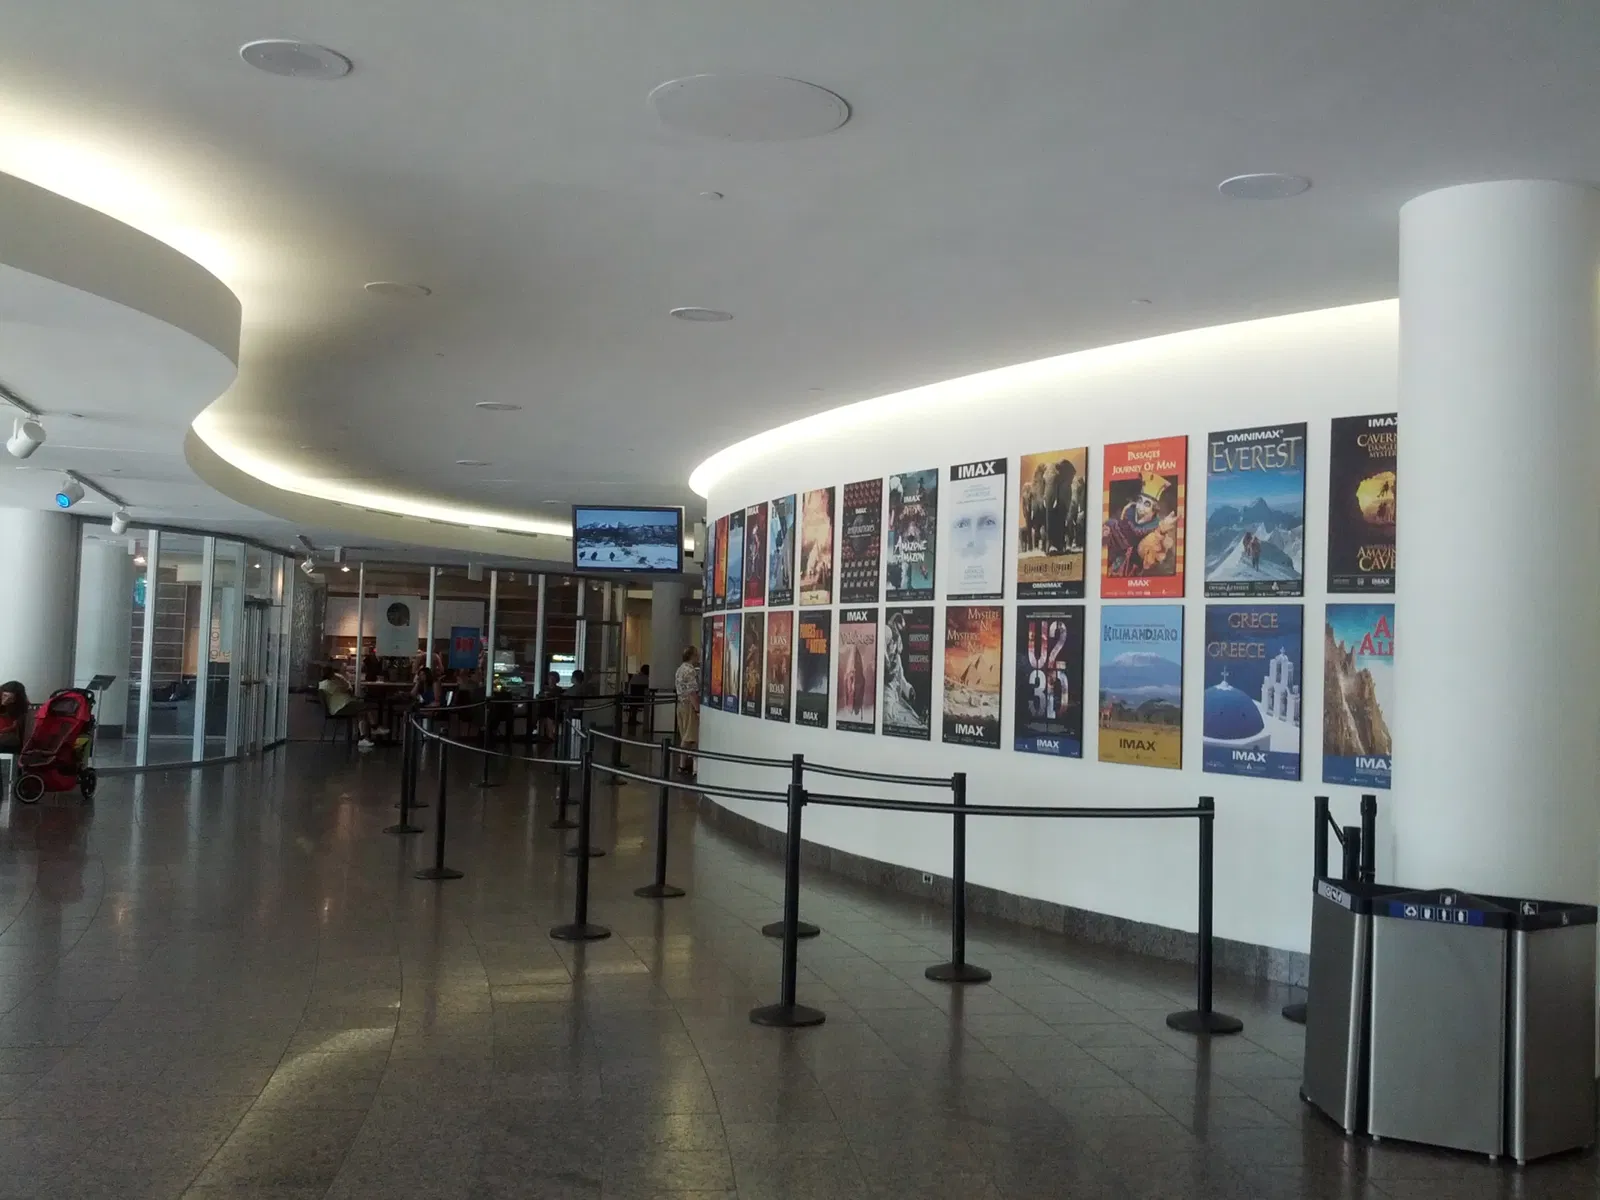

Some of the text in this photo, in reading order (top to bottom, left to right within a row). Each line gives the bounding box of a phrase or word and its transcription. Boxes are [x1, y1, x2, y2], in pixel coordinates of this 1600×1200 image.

[1127, 450, 1160, 460] PASSAGES
[1211, 436, 1302, 472] EVEREST
[957, 462, 995, 478] IMAX
[1112, 464, 1141, 474] JOURNEY
[1157, 461, 1175, 470] MAN
[846, 611, 867, 621] IMAX
[1103, 624, 1177, 641] KILIMANDJARO
[1207, 642, 1265, 658] GREECE
[770, 707, 782, 715] IMAX
[802, 711, 818, 720] IMAX
[955, 723, 984, 736] IMAX
[1036, 738, 1059, 748] IMAX
[1119, 738, 1156, 751] IMAX
[1232, 750, 1266, 762] IMAX
